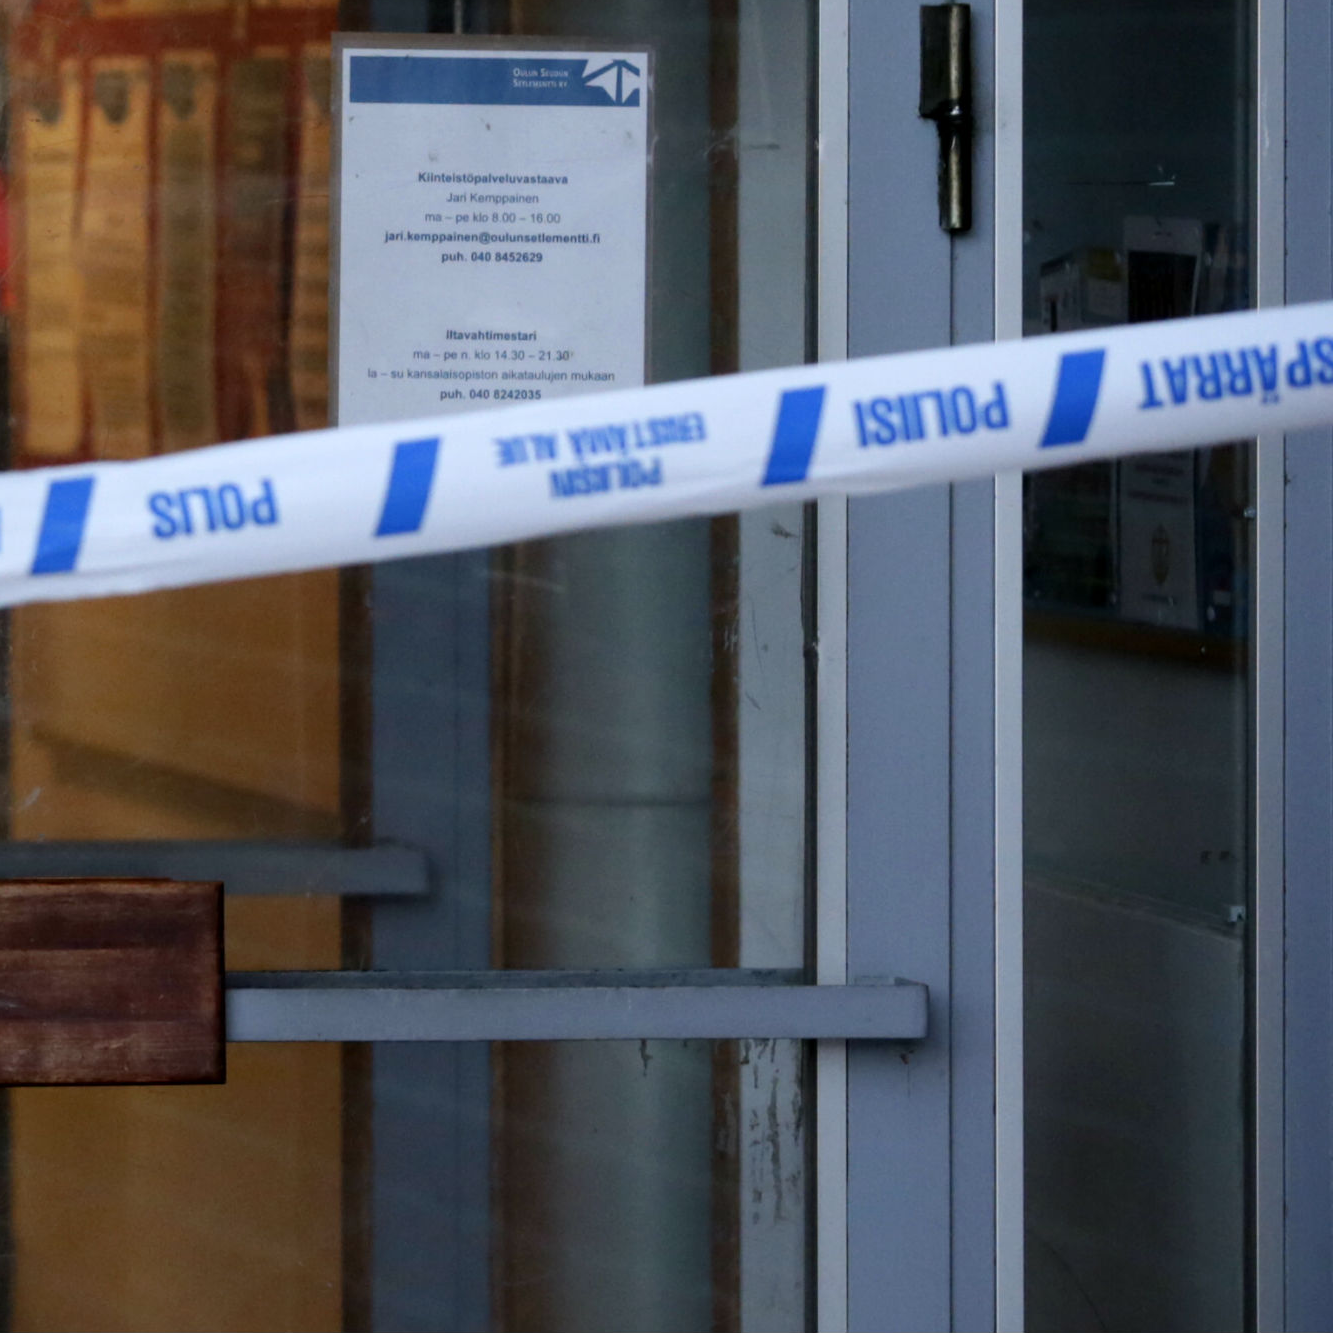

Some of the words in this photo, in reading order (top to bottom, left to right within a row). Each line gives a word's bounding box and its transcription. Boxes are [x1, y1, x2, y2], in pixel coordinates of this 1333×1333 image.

[418, 172, 569, 186] Kiinteistöpalveluvastaava
[446, 193, 467, 204] Jari
[470, 193, 540, 206] Kemppainen
[425, 214, 442, 223] ma
[455, 214, 470, 225] pe
[472, 212, 489, 223] klo
[491, 213, 517, 224] 8.00
[530, 213, 561, 224] 16.00
[384, 231, 601, 245] jari.kemppainen@oulunsetlementti.fi
[441, 252, 467, 263] puh.
[471, 252, 492, 262] 040
[494, 252, 543, 263] 8452629
[446, 330, 537, 342] Iltavahtimestari
[413, 352, 430, 360] ma
[443, 352, 458, 363] pe
[474, 350, 491, 360] klo
[495, 350, 525, 361] 14.30
[390, 370, 404, 379] su
[407, 368, 498, 382] kansalaisopiston
[501, 369, 568, 383] aikataulujen
[570, 370, 616, 382] mukaan
[1137, 334, 1333, 410] SPÄRRAT
[440, 389, 466, 402] puh.
[468, 389, 490, 400] 040
[493, 389, 542, 401] 8242035
[854, 380, 1012, 448] POLIISI
[495, 435, 560, 467] ALUE
[151, 478, 278, 540] POLIS
